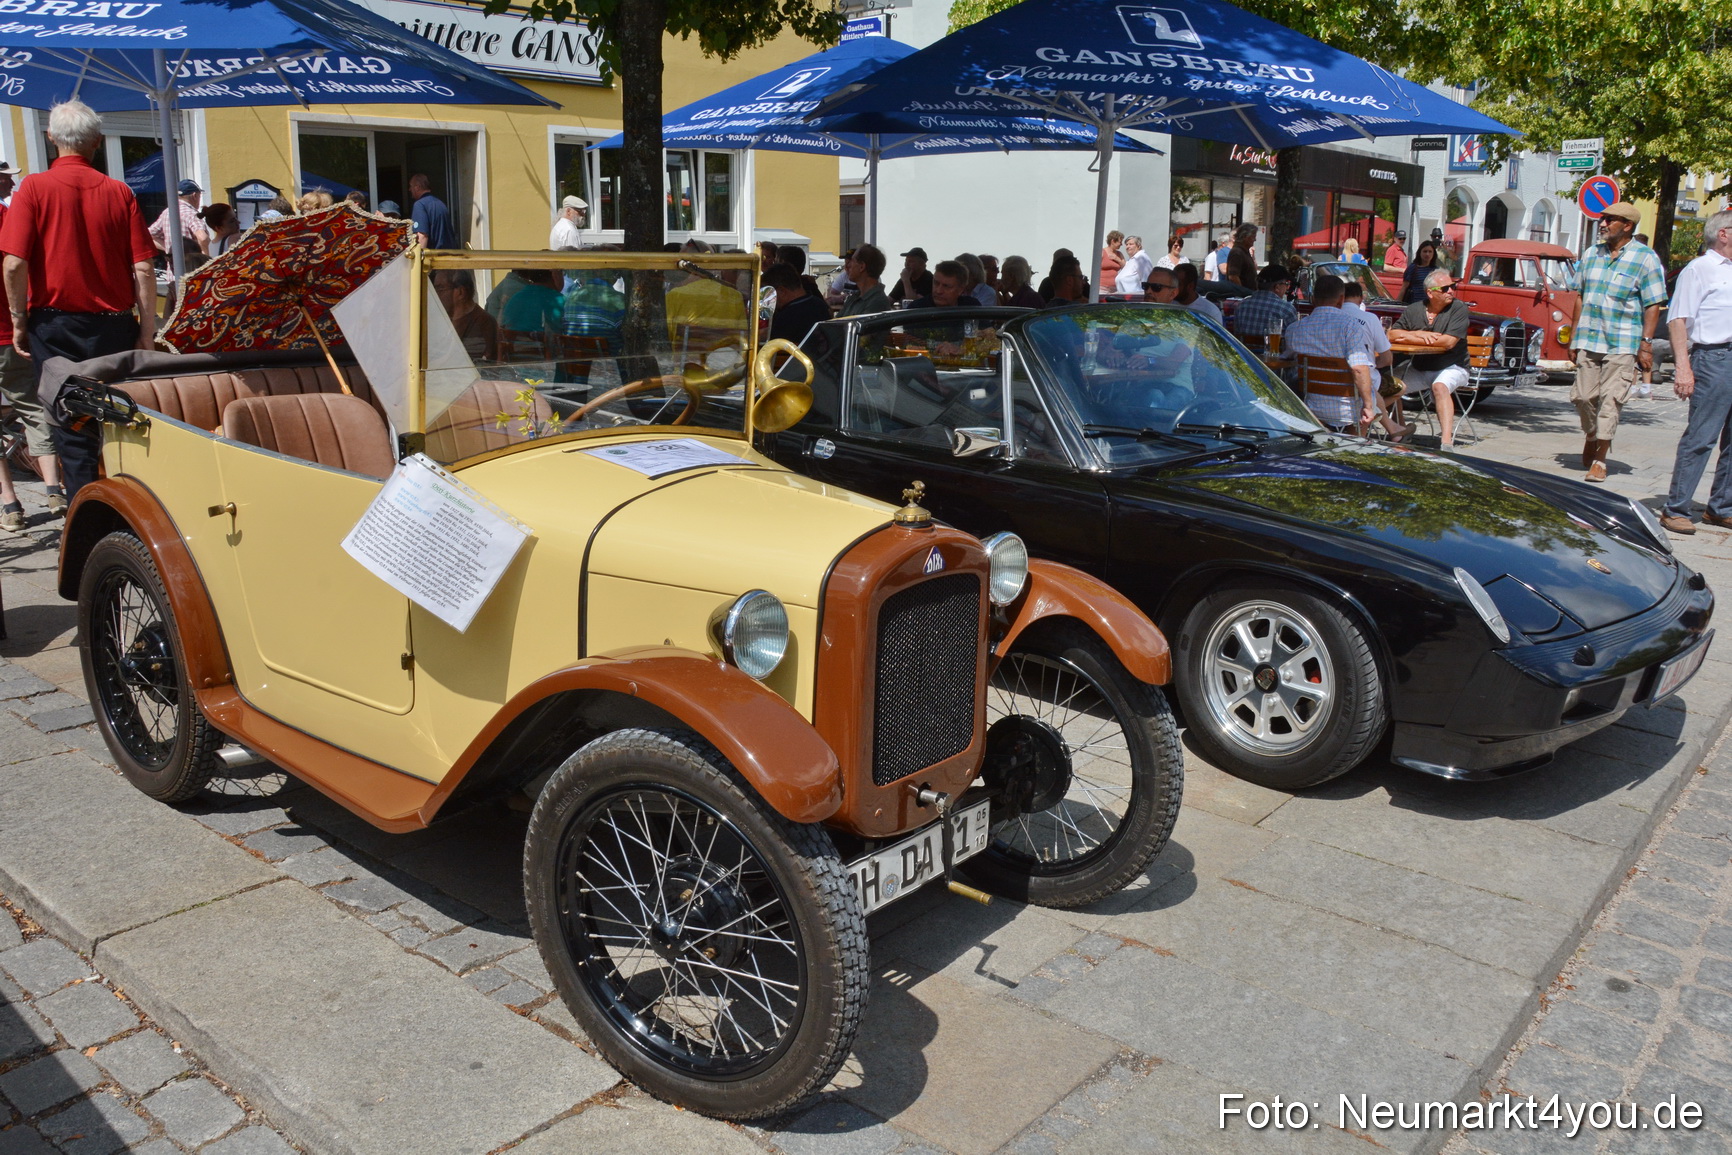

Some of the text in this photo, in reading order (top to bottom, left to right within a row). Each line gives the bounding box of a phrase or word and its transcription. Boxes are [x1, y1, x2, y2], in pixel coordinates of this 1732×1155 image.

[34, 22, 188, 40] Schluck
[398, 18, 501, 55] ittlere
[840, 32, 865, 41] Mittlere
[846, 23, 875, 32] Gasthaus
[1036, 46, 1316, 84] GANSBRÄU
[986, 64, 1390, 111] Neumarkt's guter Schluck
[690, 100, 822, 121] GANSBRÄU
[919, 116, 1007, 130] Neumarkt's
[926, 553, 943, 573] DIXI
[976, 808, 987, 822] 05
[974, 834, 985, 848] 10
[900, 836, 934, 890] DA
